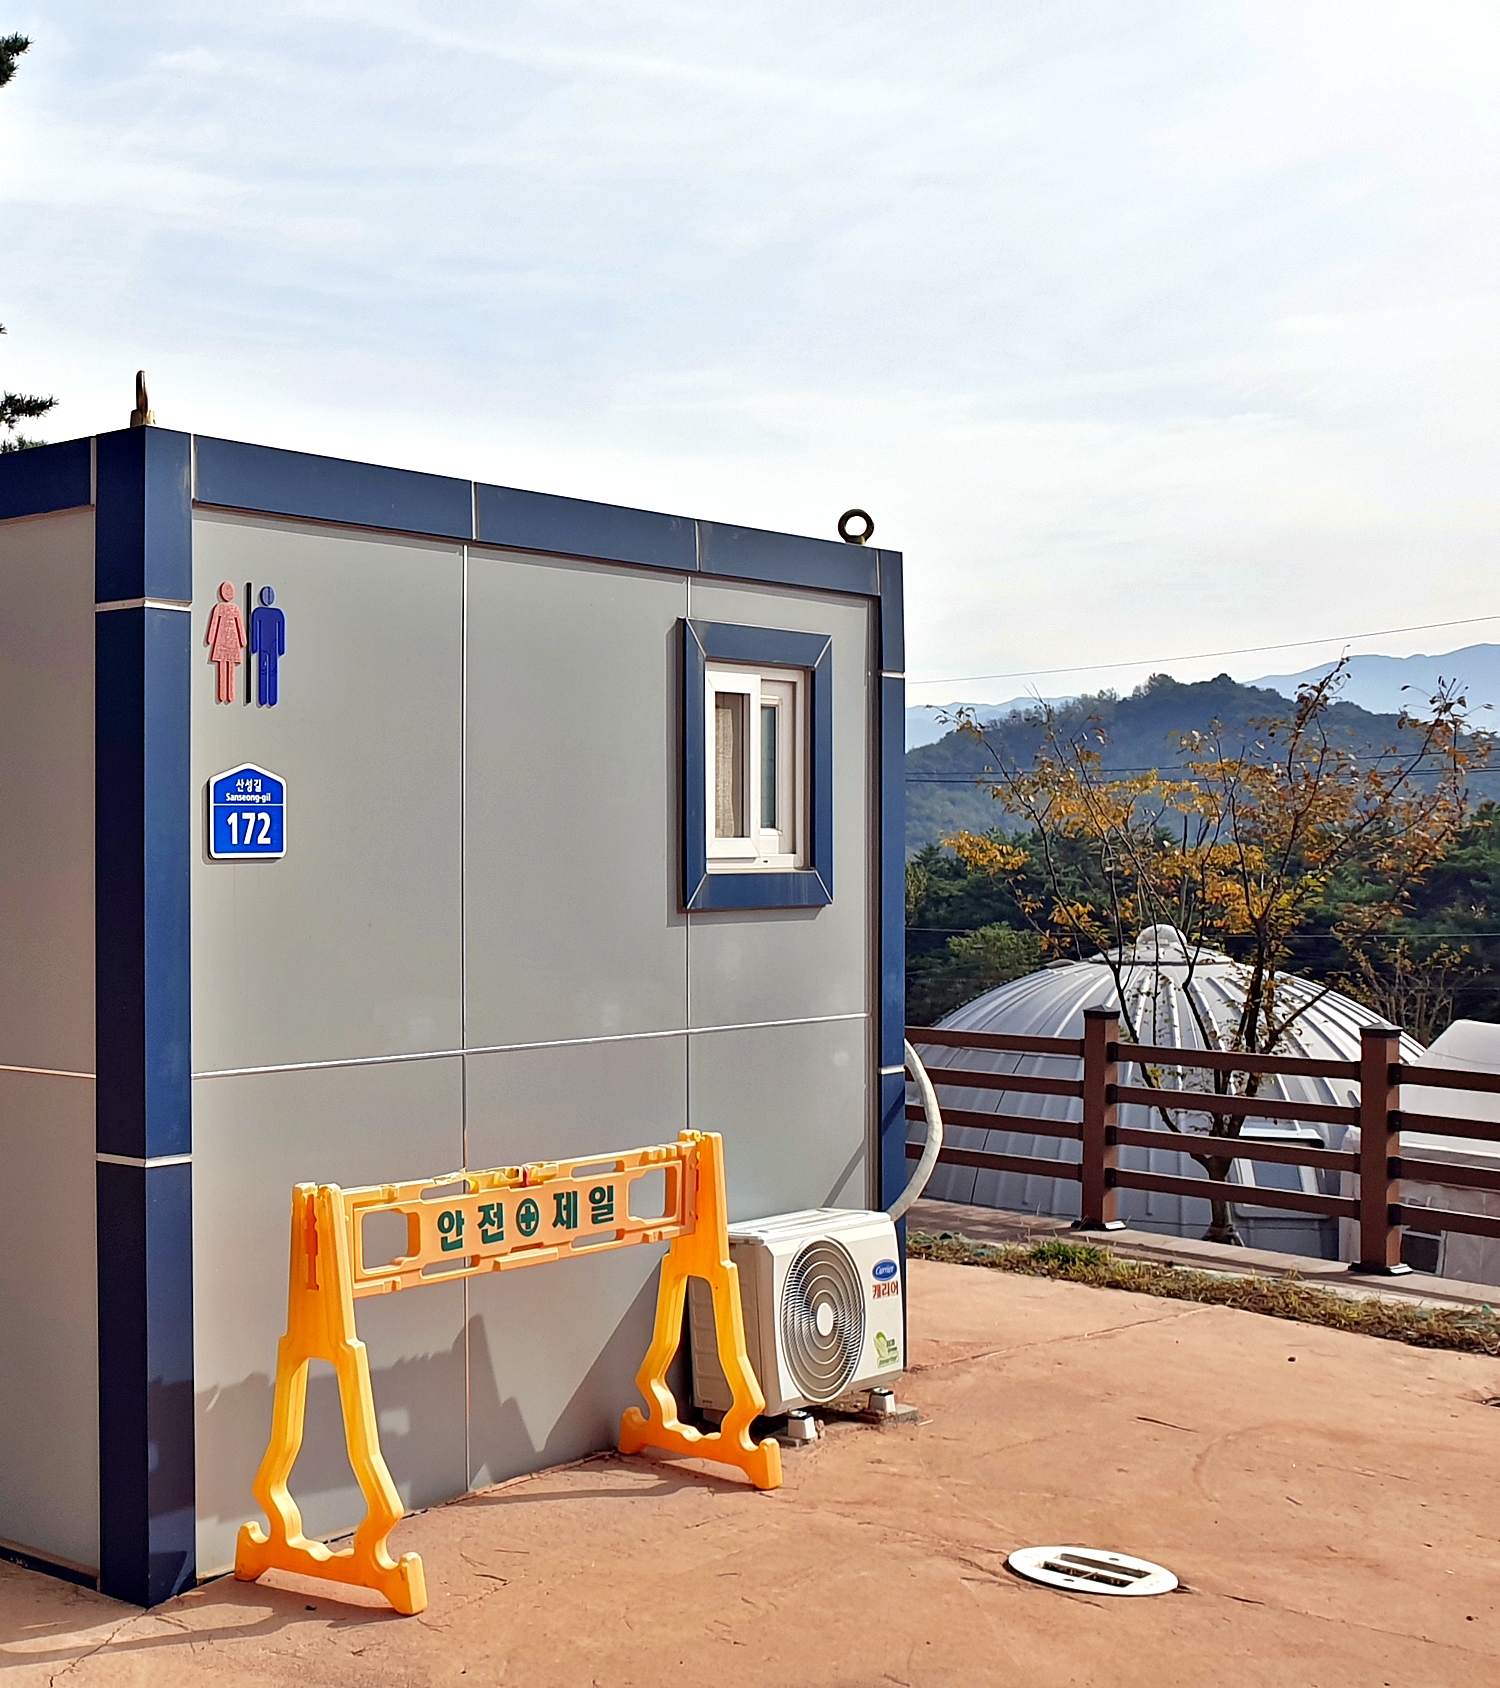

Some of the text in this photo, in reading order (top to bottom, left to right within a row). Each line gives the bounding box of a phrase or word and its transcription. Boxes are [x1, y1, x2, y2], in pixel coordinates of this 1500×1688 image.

[236, 778, 262, 793] 산성길
[225, 792, 271, 803] Sanseong-gil
[227, 812, 271, 845] 172
[437, 1185, 615, 1252] 안전 제일
[875, 1264, 895, 1276] Carrier
[872, 1280, 899, 1299] 캐리어
